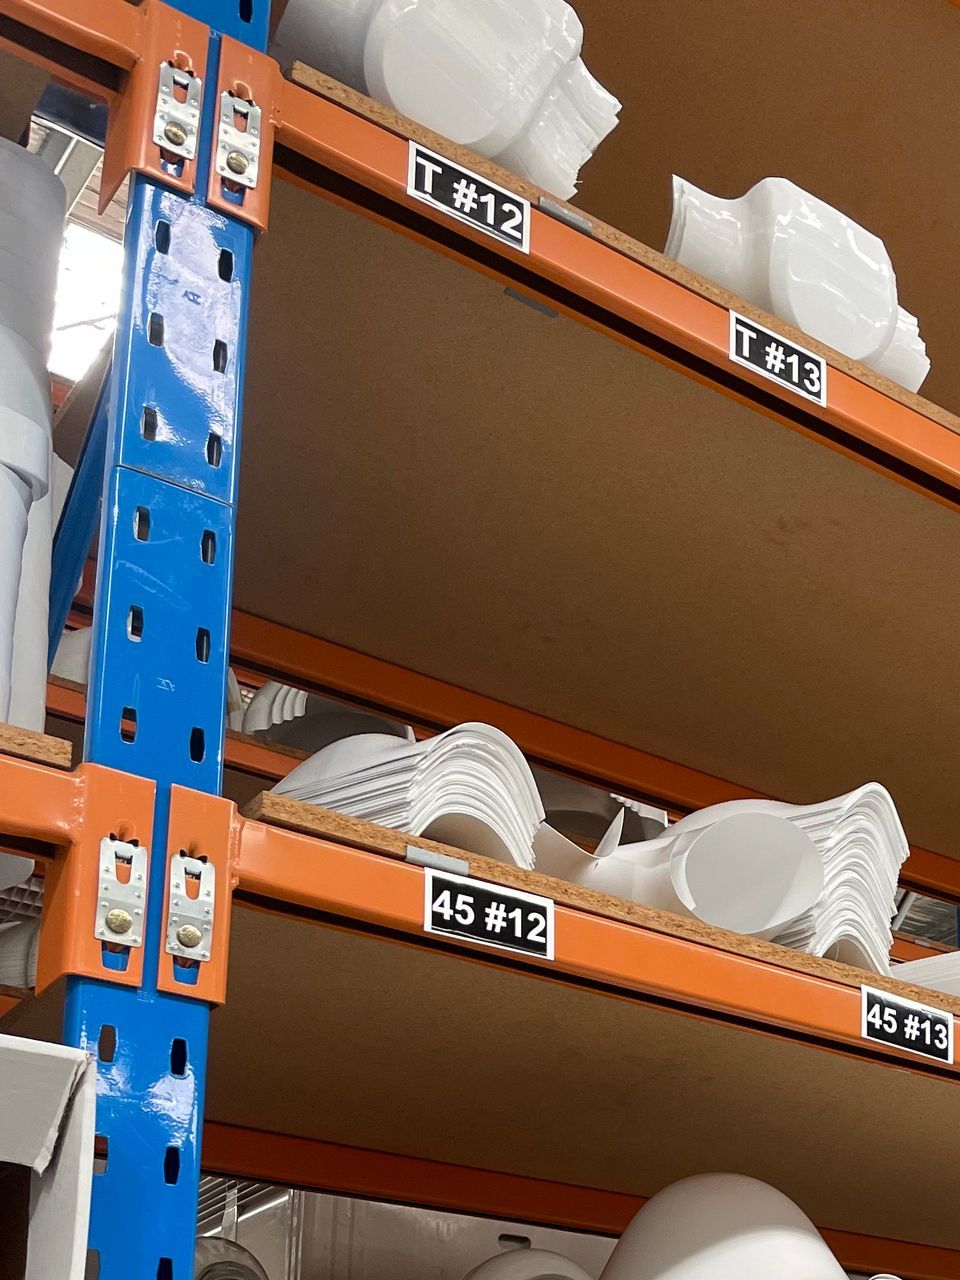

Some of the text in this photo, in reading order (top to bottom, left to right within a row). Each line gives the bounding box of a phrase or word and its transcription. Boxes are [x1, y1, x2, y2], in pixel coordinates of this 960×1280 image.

[416, 156, 523, 240] T #12
[735, 323, 821, 393] T #13
[431, 889, 547, 943] 45 #12
[867, 1003, 948, 1050] 45 #13
